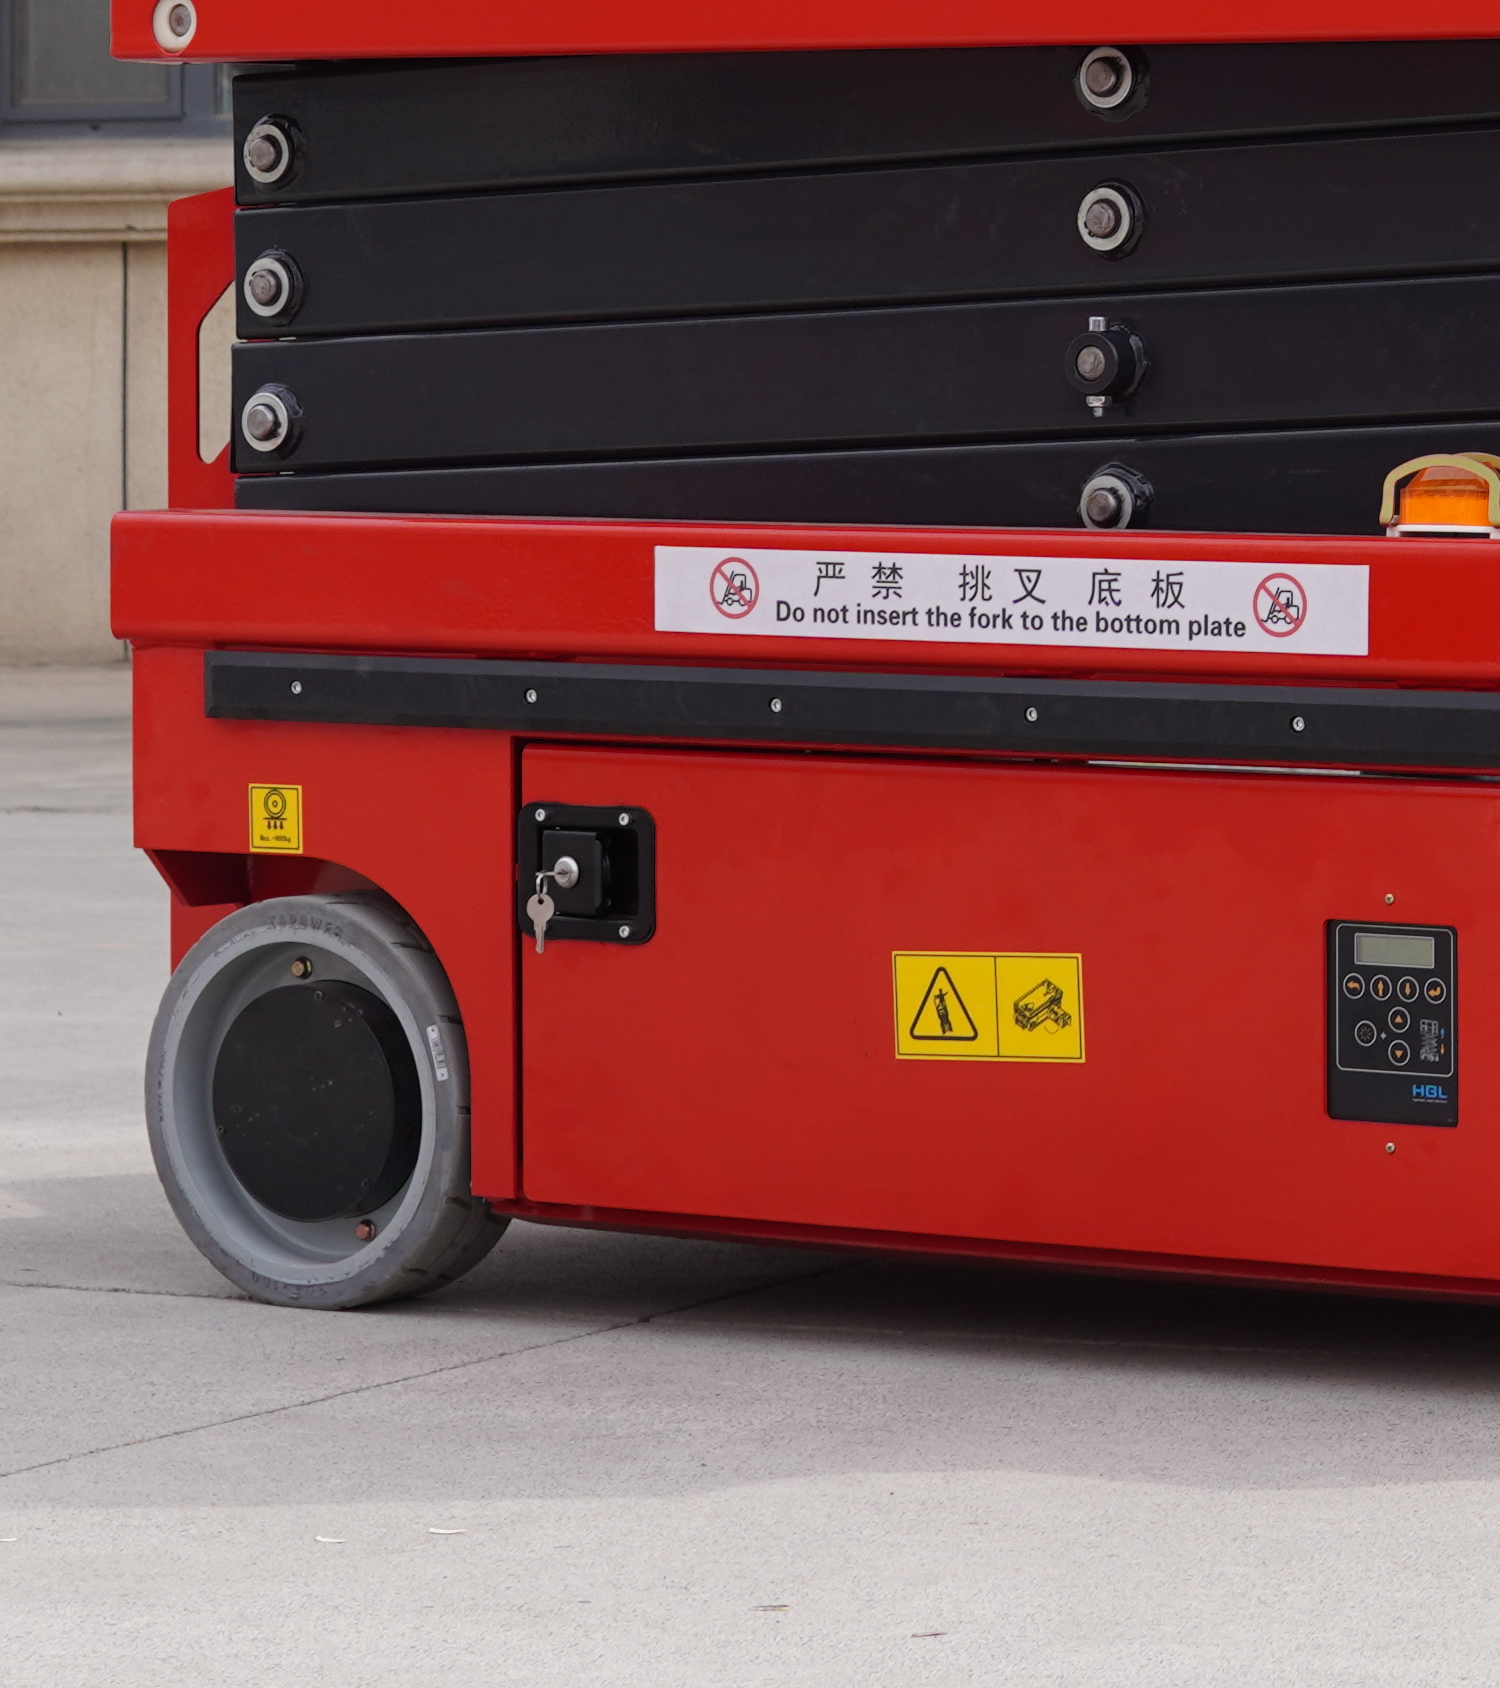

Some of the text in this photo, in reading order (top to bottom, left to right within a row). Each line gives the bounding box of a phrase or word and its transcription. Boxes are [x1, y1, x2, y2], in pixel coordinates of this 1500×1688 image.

[776, 600, 1246, 641] Do not insert the fork to the bottom plate
